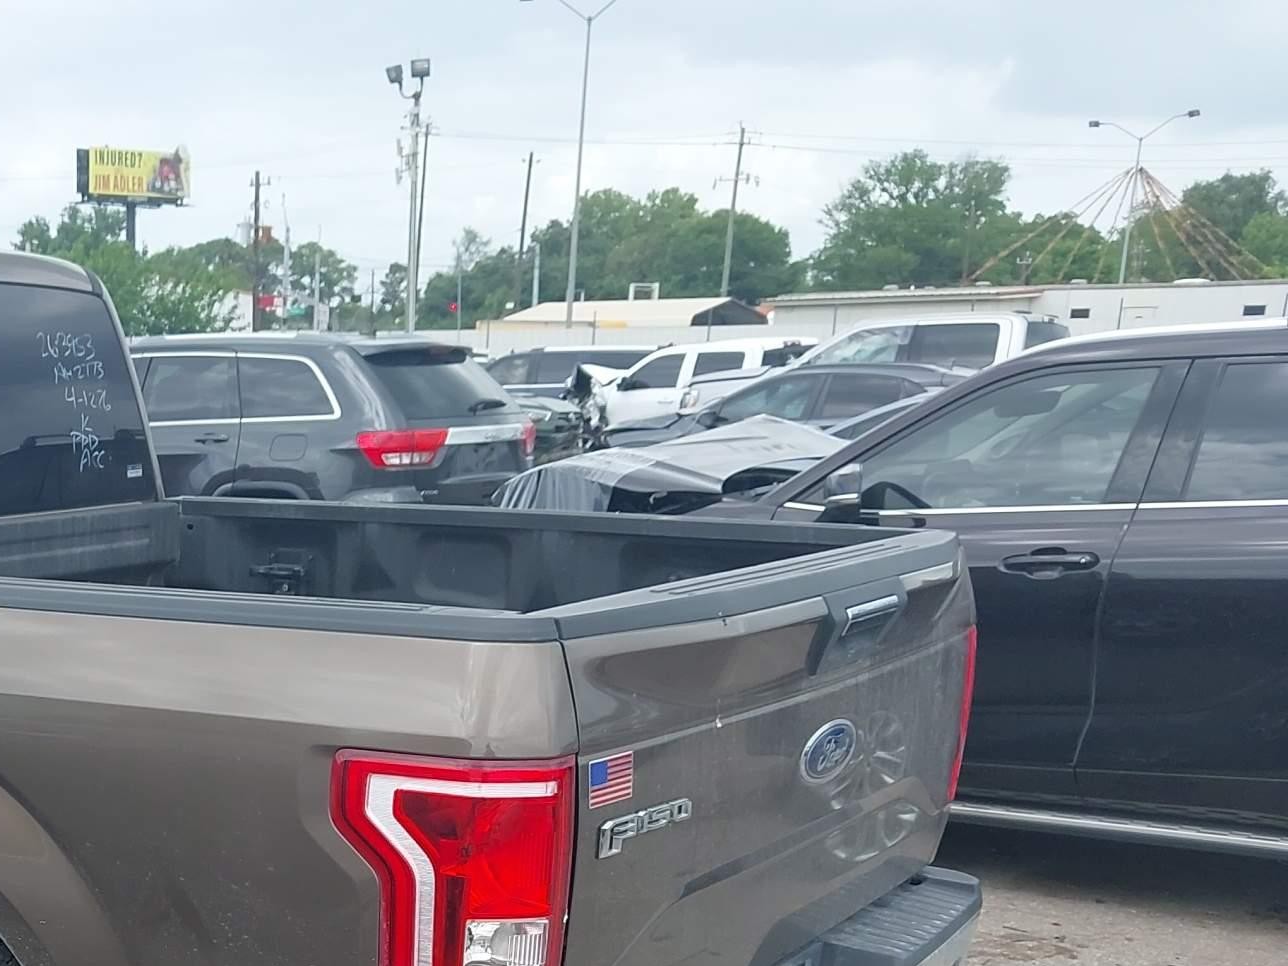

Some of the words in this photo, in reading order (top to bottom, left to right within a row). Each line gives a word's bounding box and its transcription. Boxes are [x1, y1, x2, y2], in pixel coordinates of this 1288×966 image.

[95, 149, 143, 168] INJURED?
[94, 174, 111, 191] JIM
[113, 175, 144, 193] ADLER
[813, 729, 850, 764] Ford
